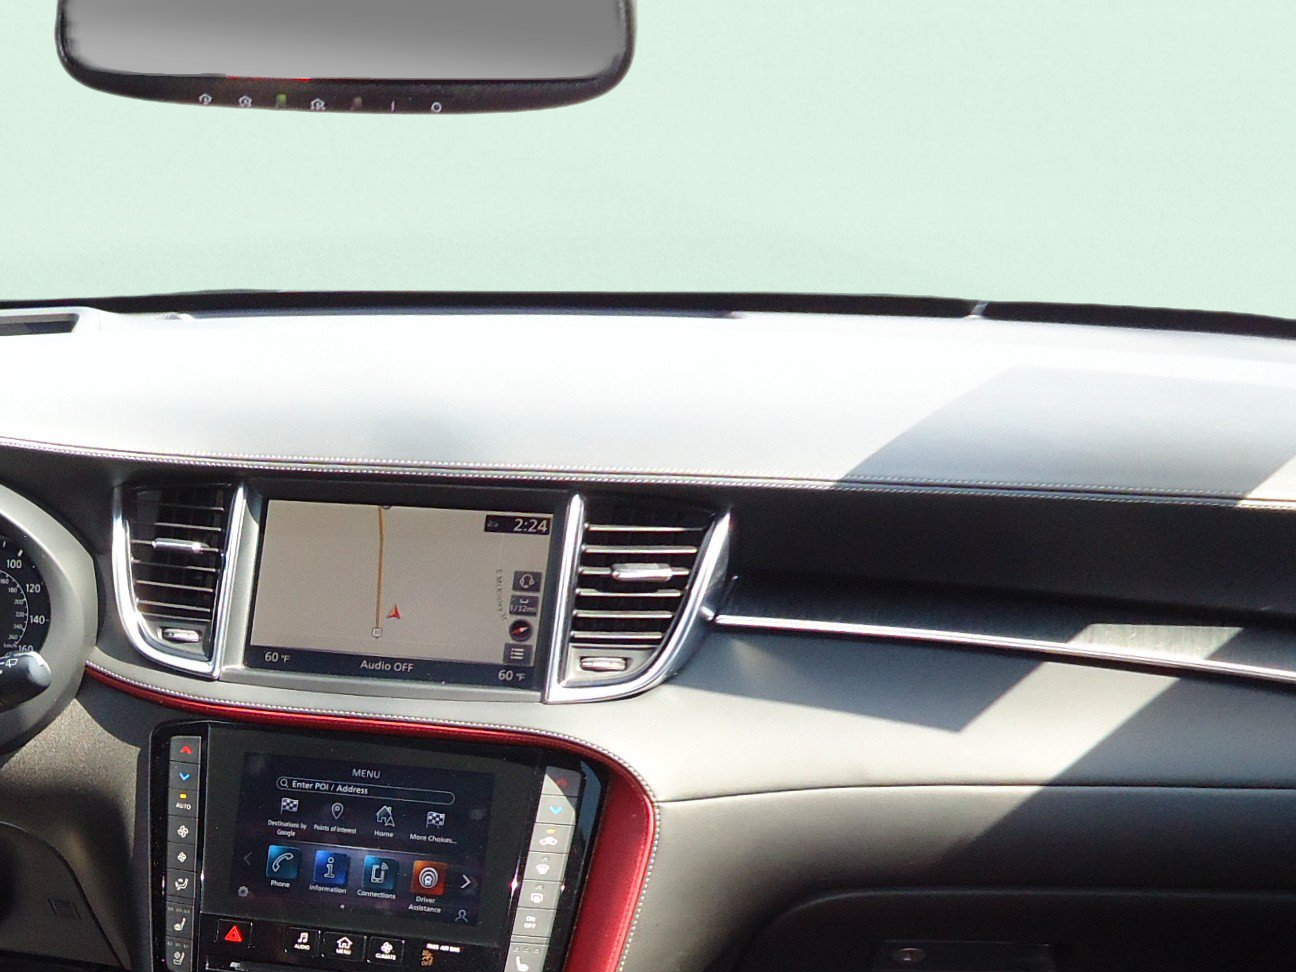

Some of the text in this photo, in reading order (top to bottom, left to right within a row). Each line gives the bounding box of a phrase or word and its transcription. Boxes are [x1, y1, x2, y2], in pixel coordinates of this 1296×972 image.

[513, 518, 548, 533] 2:24
[6, 559, 23, 569] 100
[26, 583, 41, 593] 120
[29, 615, 46, 625] 140
[264, 651, 279, 663] 60
[360, 659, 414, 673] Audio OFF
[498, 669, 514, 681] 60
[352, 768, 381, 779] MENU
[292, 780, 314, 790] Enter
[336, 784, 369, 795] Address
[176, 802, 192, 811] AUTO
[267, 819, 307, 831] Destinations by
[314, 823, 330, 832] Points
[276, 828, 296, 839] Google
[374, 829, 394, 839] Home
[409, 833, 427, 842] More
[270, 879, 291, 889] Phone
[309, 884, 347, 895] Information
[357, 888, 396, 900] Connections
[416, 895, 436, 904] Driver
[408, 903, 442, 914] Assistance
[523, 922, 536, 930] OFF
[294, 943, 311, 951] AUDIO
[335, 948, 352, 956] MENU
[375, 953, 397, 961] CLIMATE
